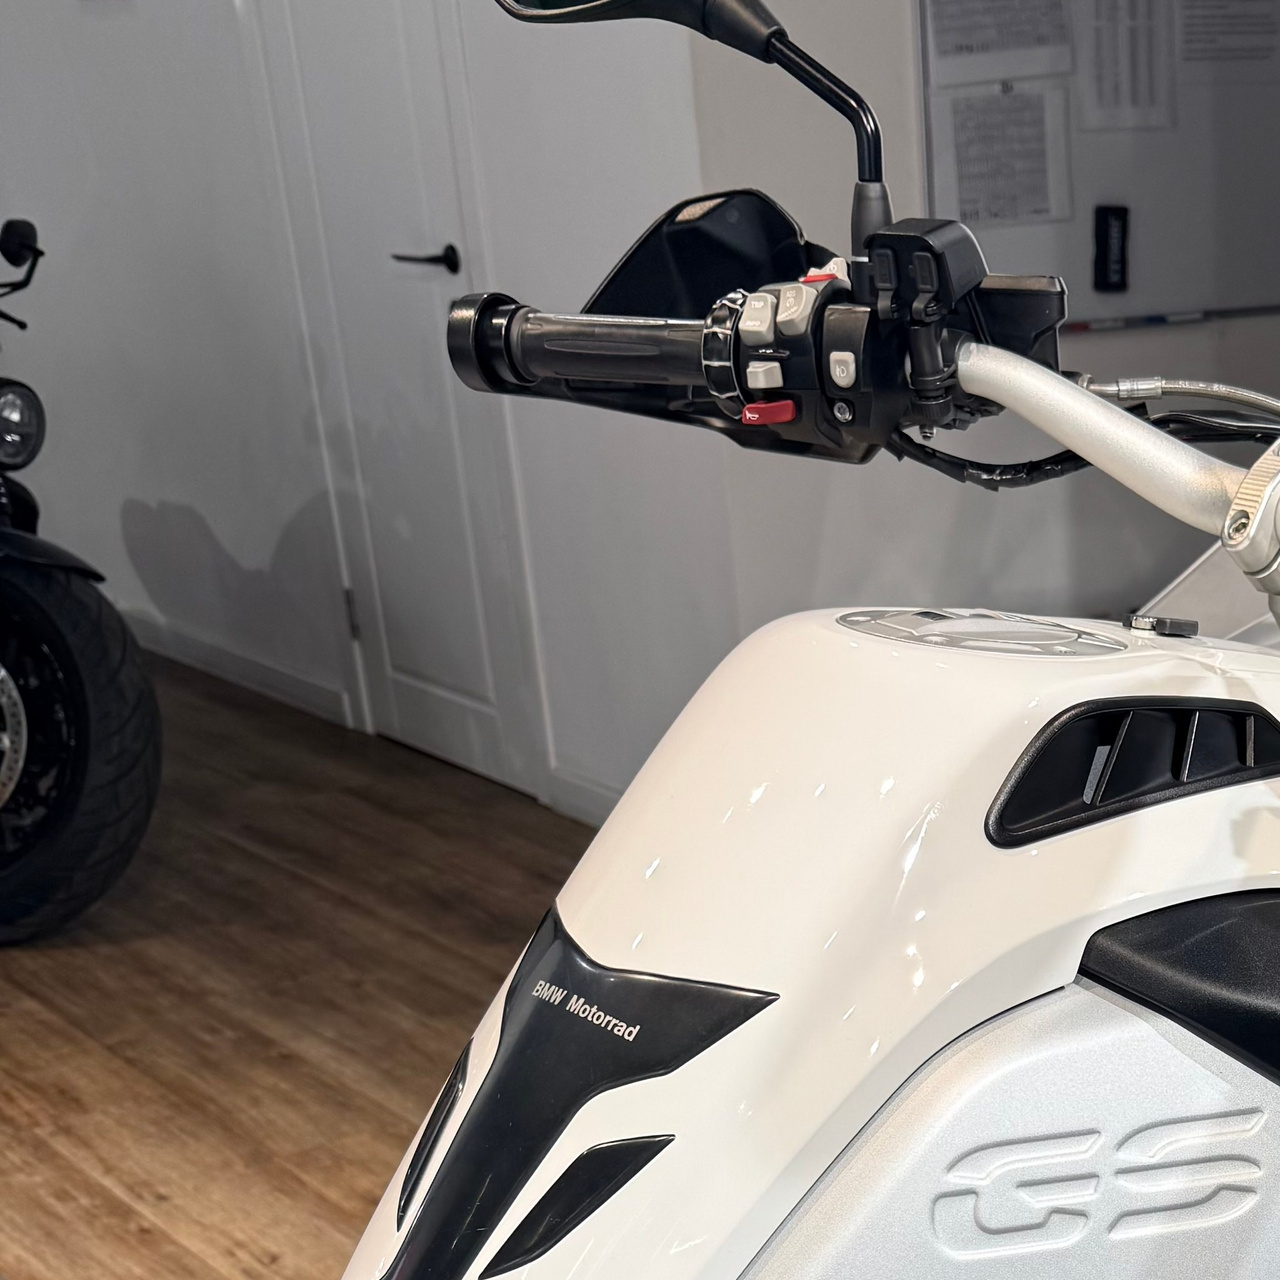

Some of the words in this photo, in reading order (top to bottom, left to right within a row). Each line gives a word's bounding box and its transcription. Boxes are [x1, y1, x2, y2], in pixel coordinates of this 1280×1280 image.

[750, 300, 765, 309] TRIP
[531, 980, 568, 1006] BMW
[566, 994, 641, 1042] Motorrad
[931, 1106, 1267, 1261] GS
